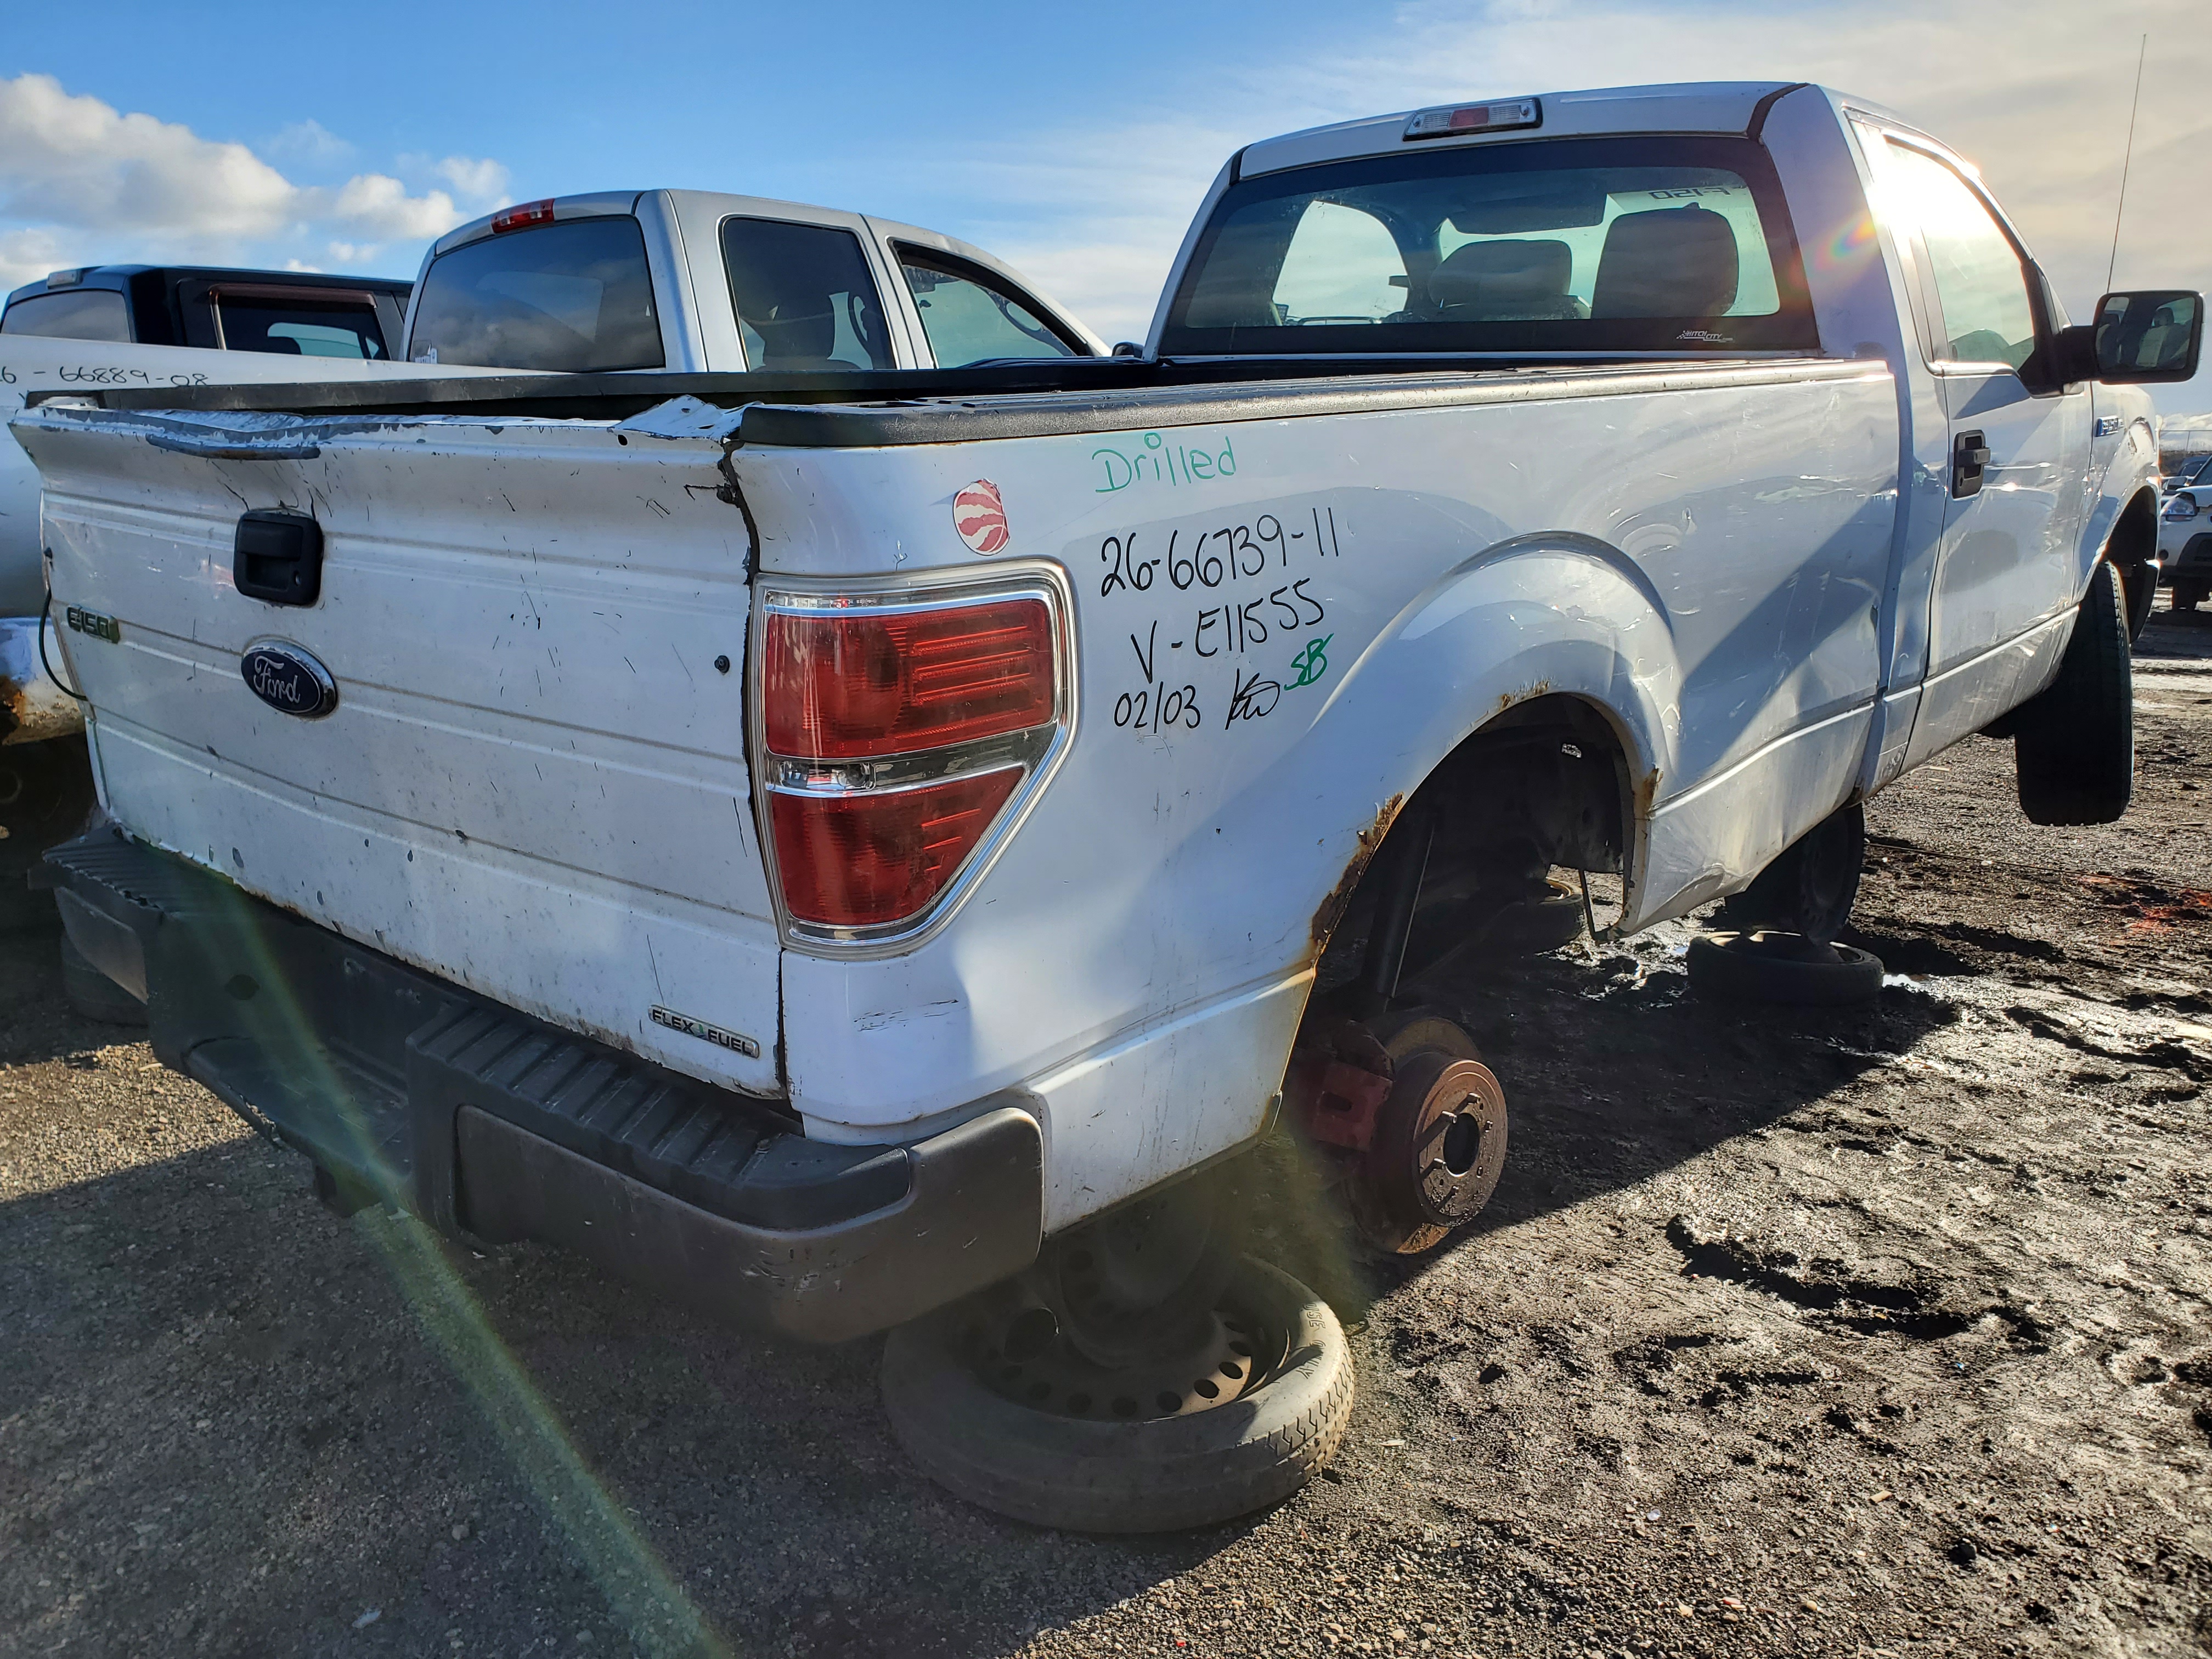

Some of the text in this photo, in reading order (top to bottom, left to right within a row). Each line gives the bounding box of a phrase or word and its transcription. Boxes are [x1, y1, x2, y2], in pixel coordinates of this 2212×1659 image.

[1092, 432, 1237, 493] Drilled
[1101, 507, 1339, 597] 26-66739-11
[253, 655, 301, 704] Ford
[1114, 681, 1201, 733] 02/03
[652, 1008, 752, 1056] FLEX FUEL
[1302, 1303, 1326, 1329] USE
